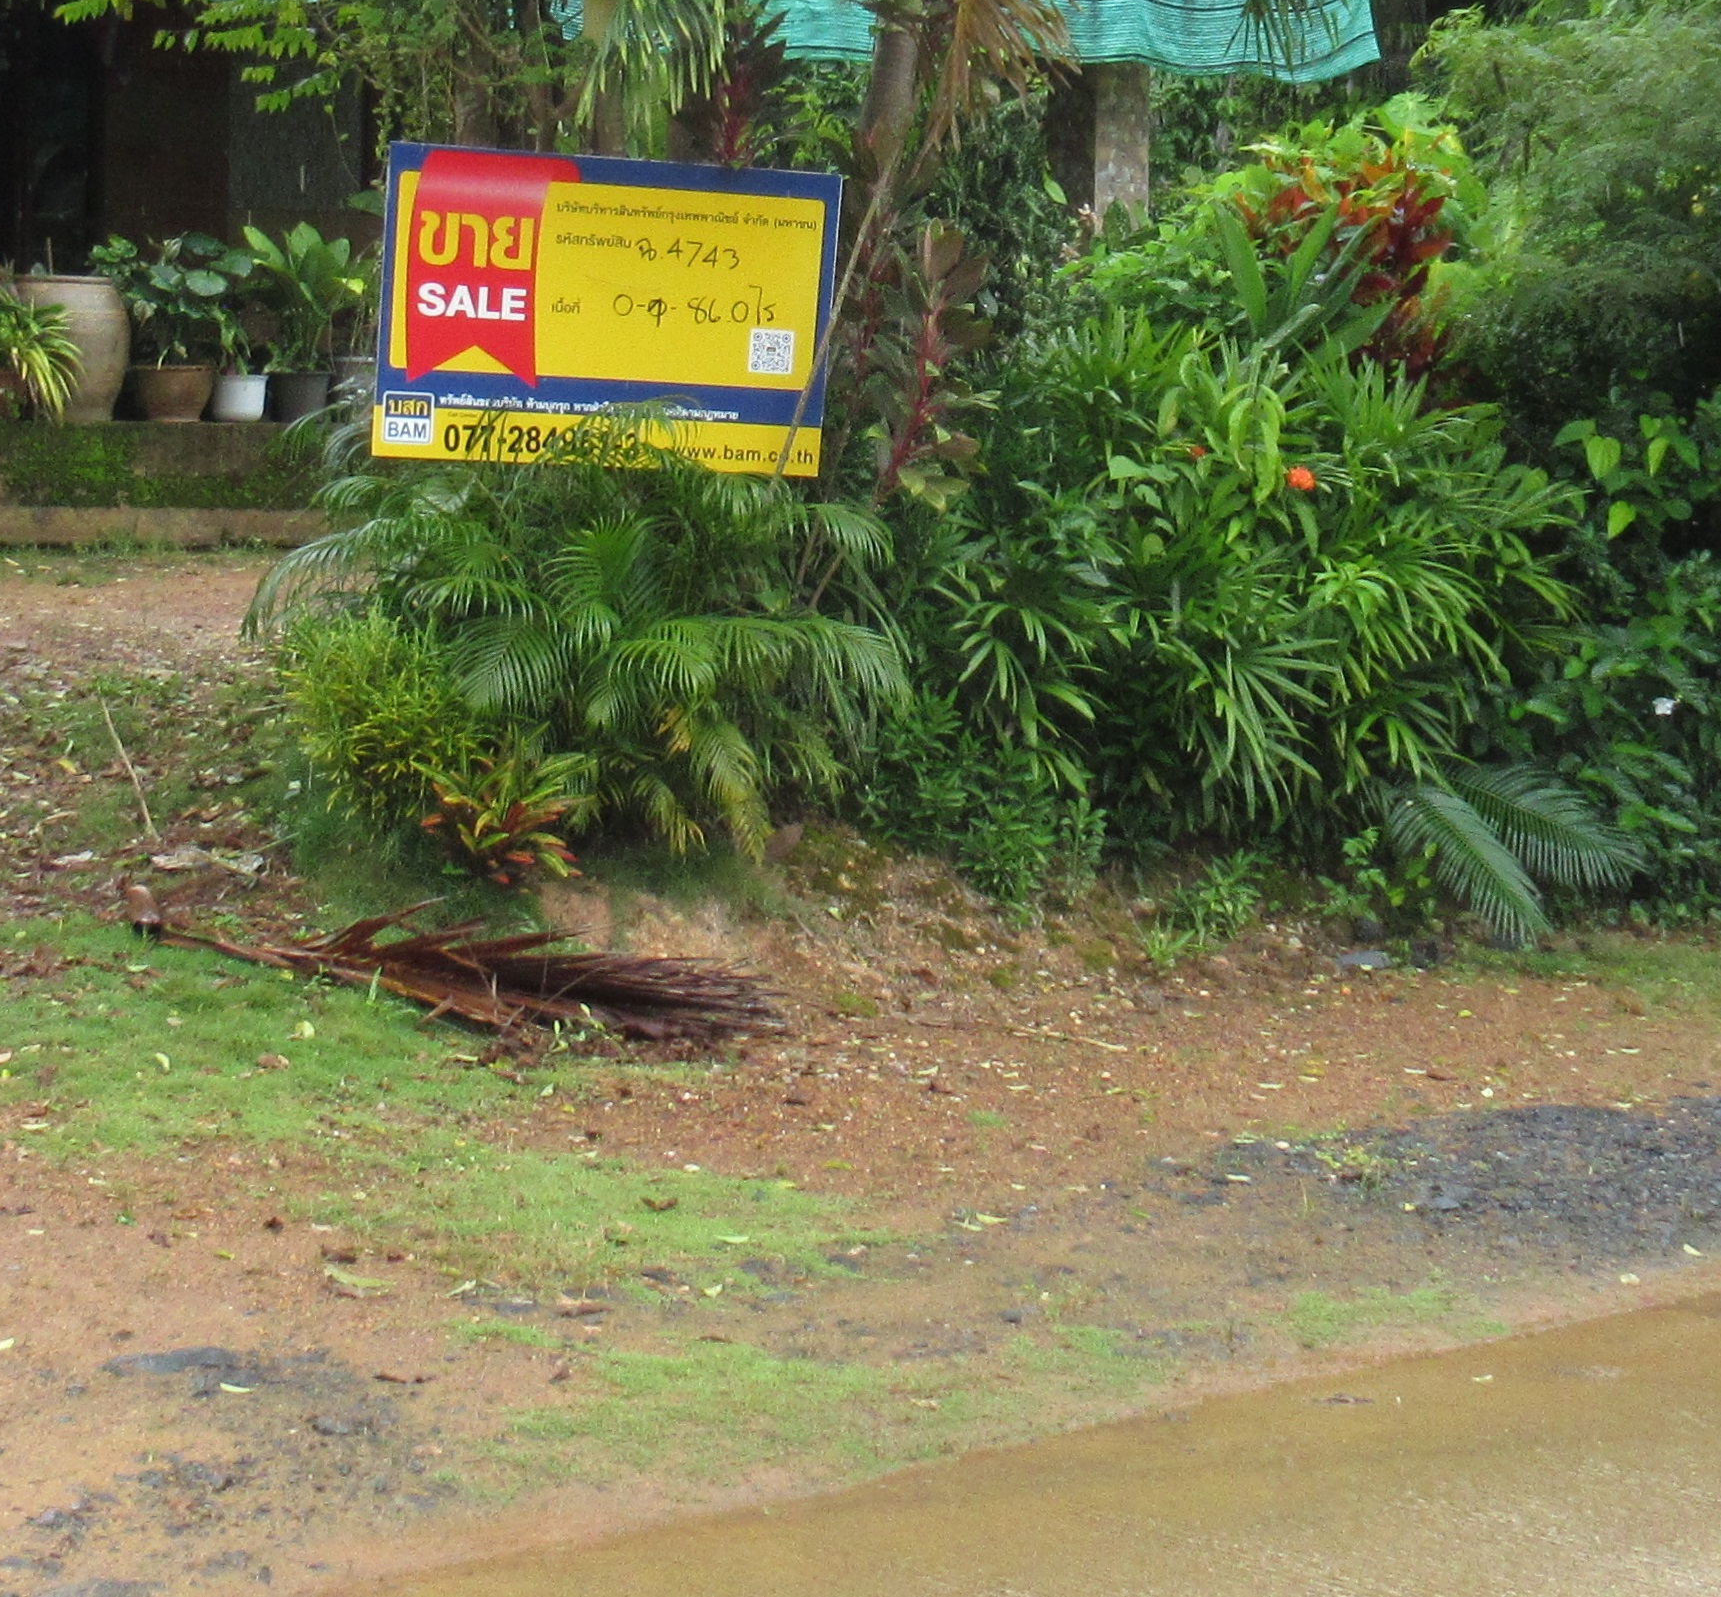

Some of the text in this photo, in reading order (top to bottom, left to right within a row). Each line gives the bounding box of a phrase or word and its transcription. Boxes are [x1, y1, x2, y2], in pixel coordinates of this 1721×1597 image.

[743, 212, 769, 226] จำกัด
[773, 218, 817, 231] (มหาชน)
[418, 210, 535, 271] ขาย
[555, 232, 632, 249] รหัสทรัพย์สิน
[417, 282, 528, 322] SALE
[551, 297, 581, 315] เนื้อที่
[388, 398, 428, 417] บสก
[387, 421, 428, 440] BAM
[676, 444, 814, 465] www.bam.c.th
